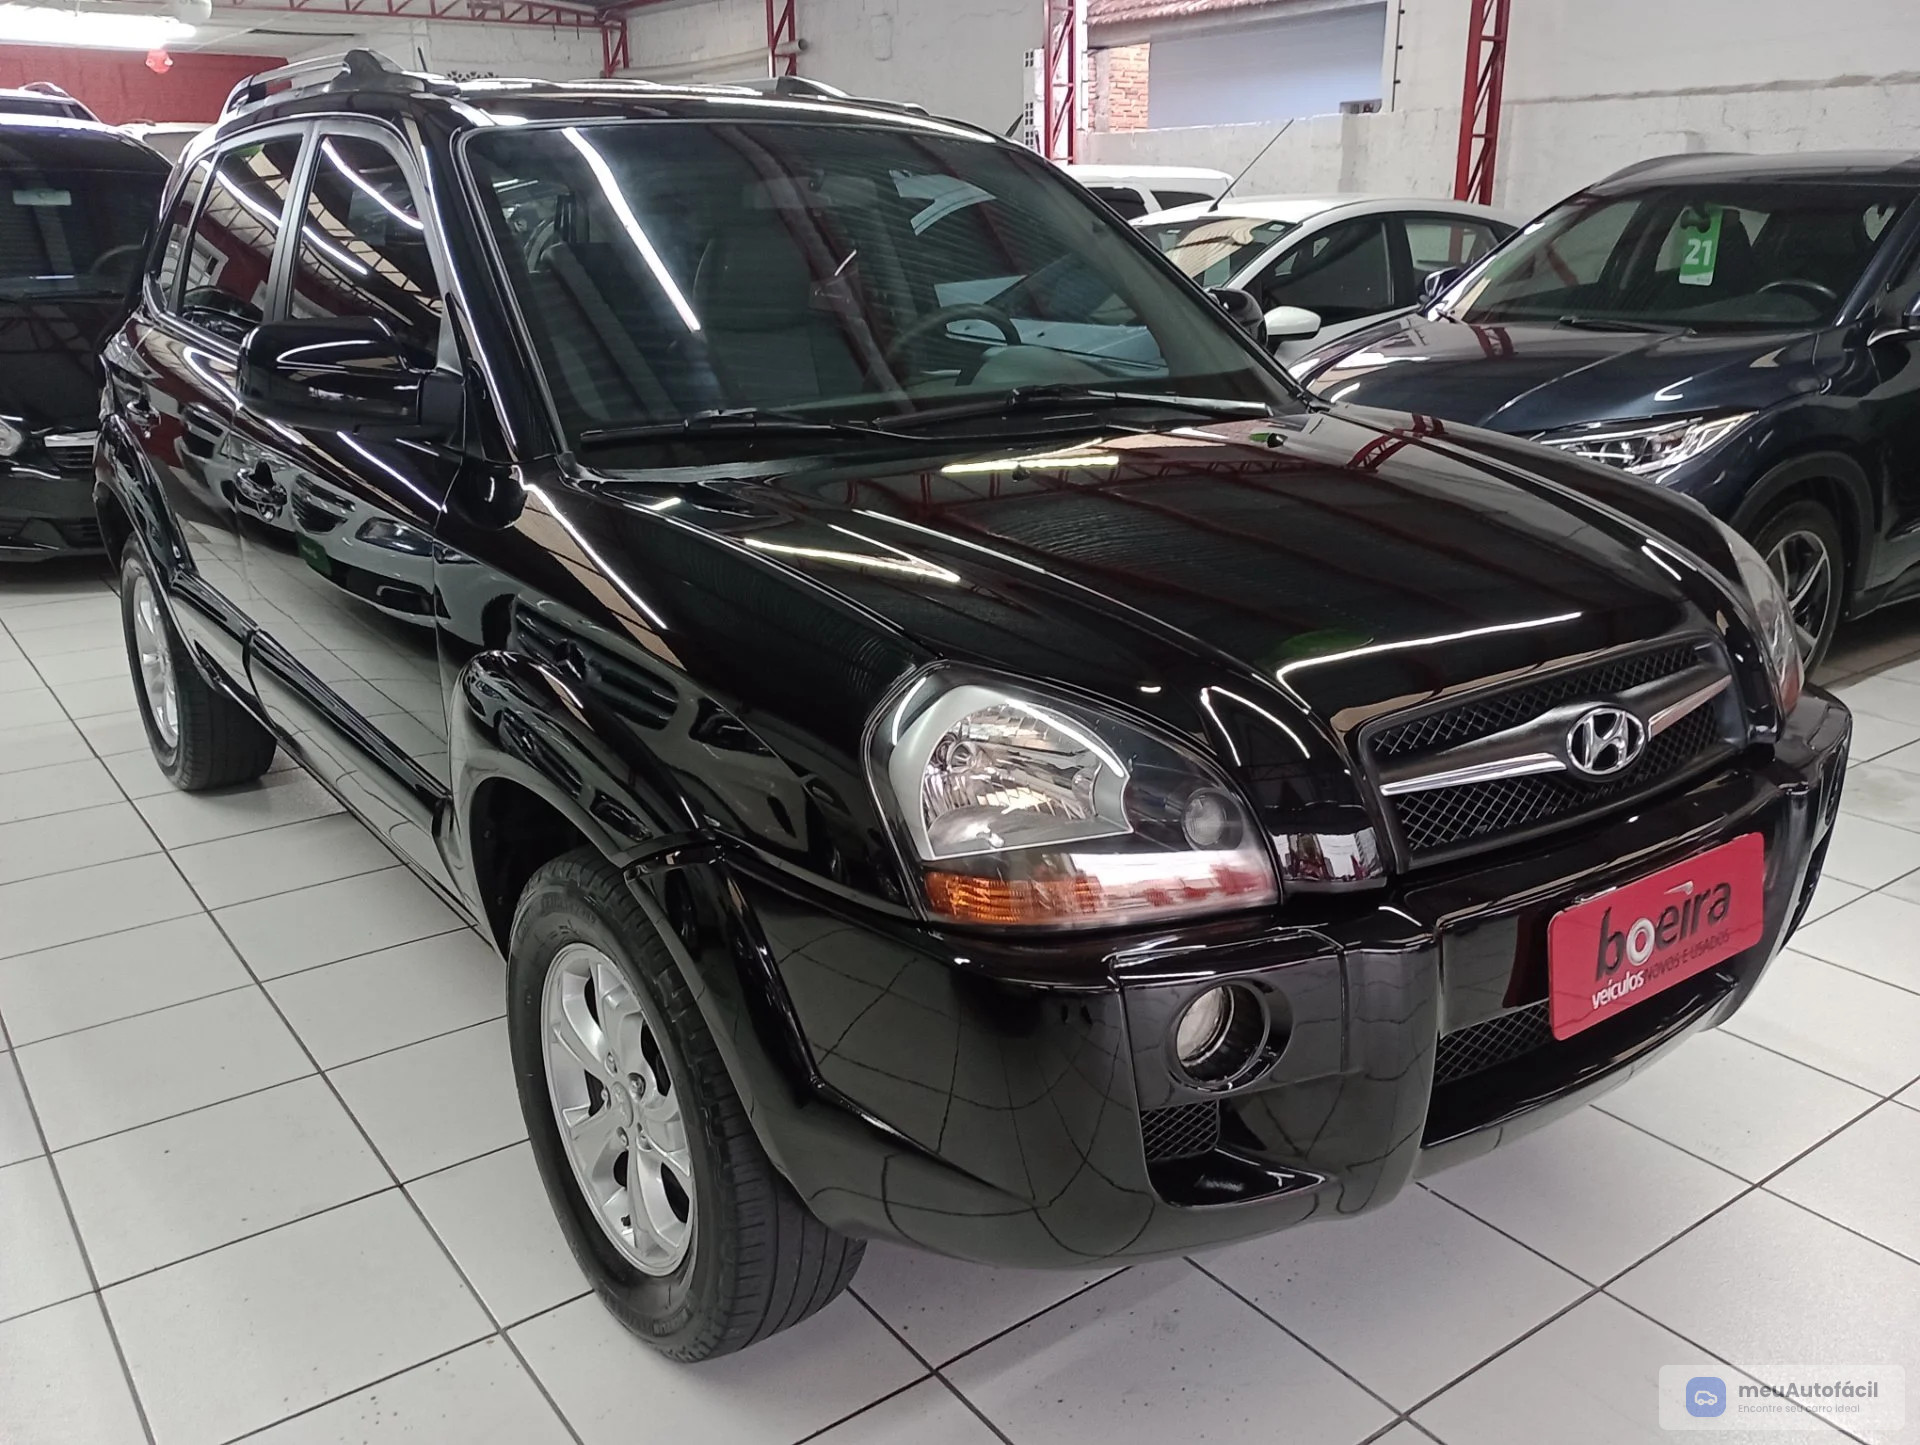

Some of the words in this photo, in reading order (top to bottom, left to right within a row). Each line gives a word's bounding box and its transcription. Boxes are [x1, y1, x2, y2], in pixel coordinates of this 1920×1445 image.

[1684, 238, 1713, 266] 21
[1595, 881, 1731, 983] boeira
[1592, 970, 1646, 1010] veículos
